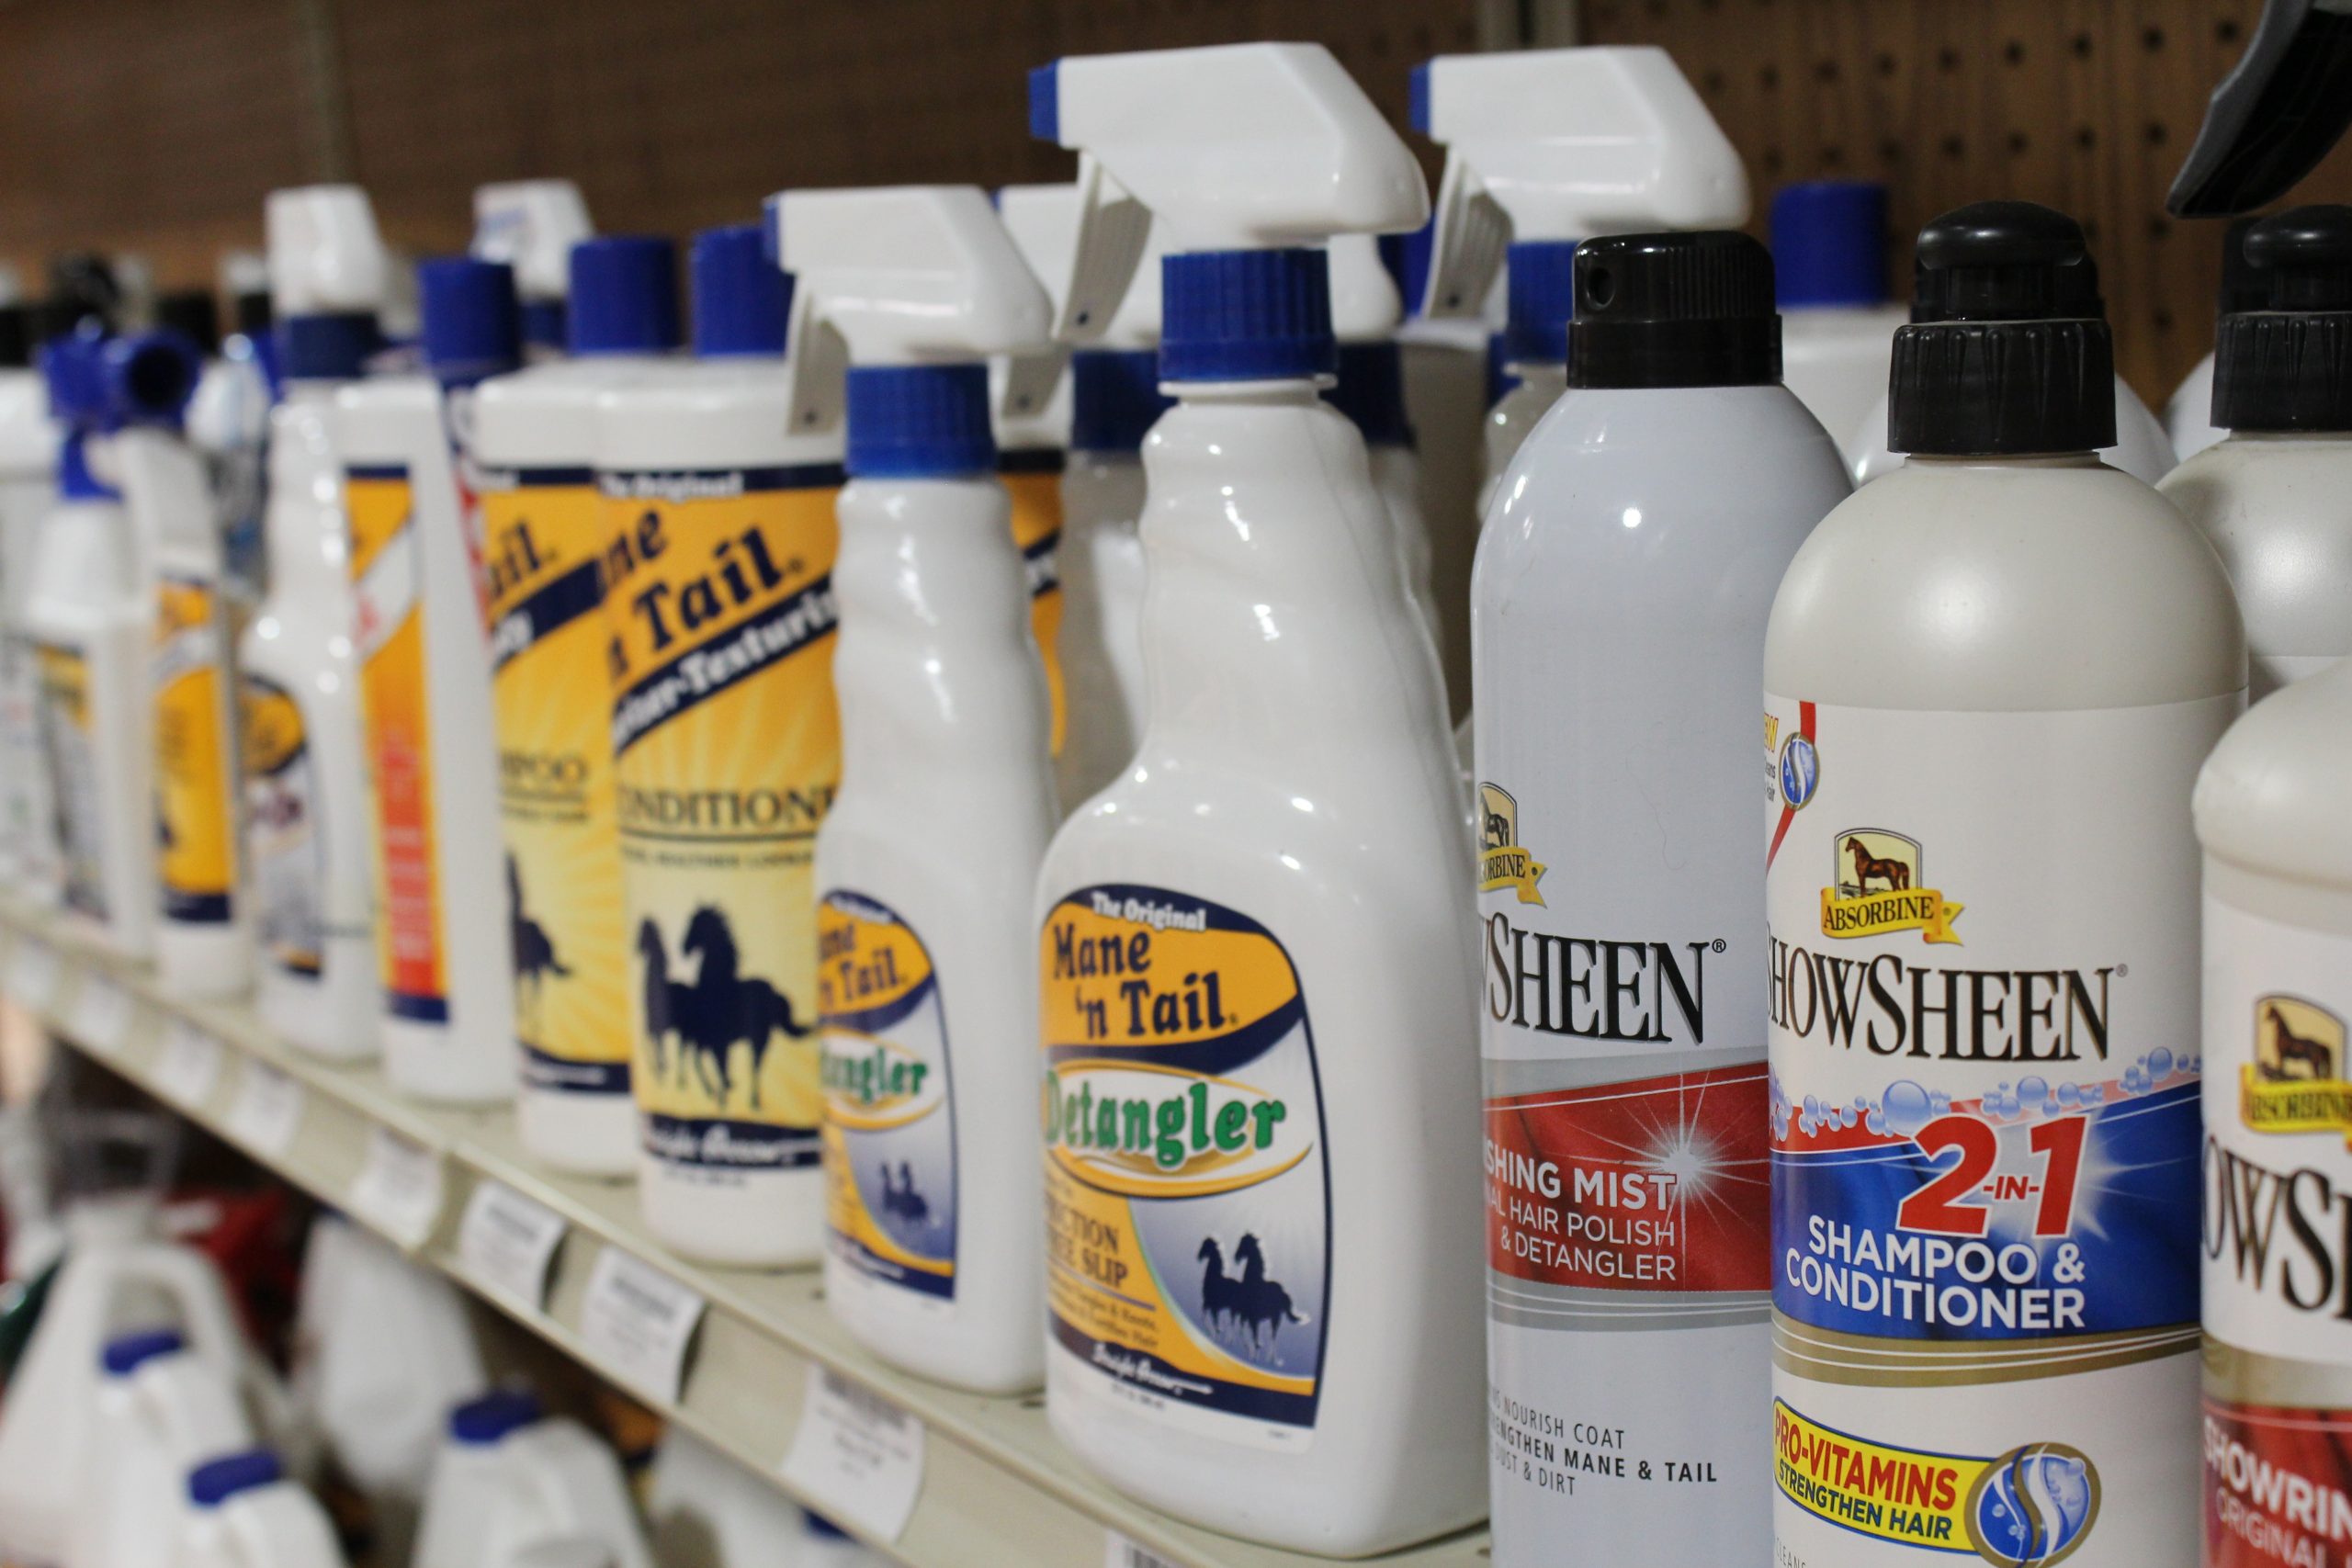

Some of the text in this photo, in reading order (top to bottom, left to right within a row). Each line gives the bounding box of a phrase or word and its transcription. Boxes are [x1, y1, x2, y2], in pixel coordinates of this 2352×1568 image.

[633, 525, 784, 651] Tail
[618, 784, 836, 827] NDITION
[1481, 853, 1526, 883] ORBINE
[1124, 898, 1207, 932] Original
[1823, 896, 1935, 931] ABSORBINE
[1053, 921, 1152, 981] Mane
[1481, 911, 1710, 1045] SHEEN
[1119, 970, 1226, 1038] Tail
[1046, 1069, 1287, 1168] Detangler
[1484, 1138, 1677, 1211] SHING MIST
[1896, 1112, 2091, 1239] 2-IN-1
[1500, 1224, 1677, 1281] & DETANGLER
[1510, 1195, 1559, 1235] HAIR
[1567, 1212, 1675, 1247] POLISH
[1807, 1213, 2086, 1285] SHAMPOO &
[1785, 1247, 2086, 1330] CONDITIONER
[1492, 1415, 1717, 1483] ENGTHEN MANE & TAIL
[1503, 1395, 1564, 1439] NOURISH
[1574, 1423, 1625, 1450] COAT
[1522, 1461, 1533, 1482] &
[1538, 1467, 1576, 1496] DIRT
[1775, 1407, 1959, 1511] PRO-VITAMINS
[2205, 1415, 2352, 1541] SHOWRIN
[1779, 1458, 1953, 1541] STRENGTHEN HAIR
